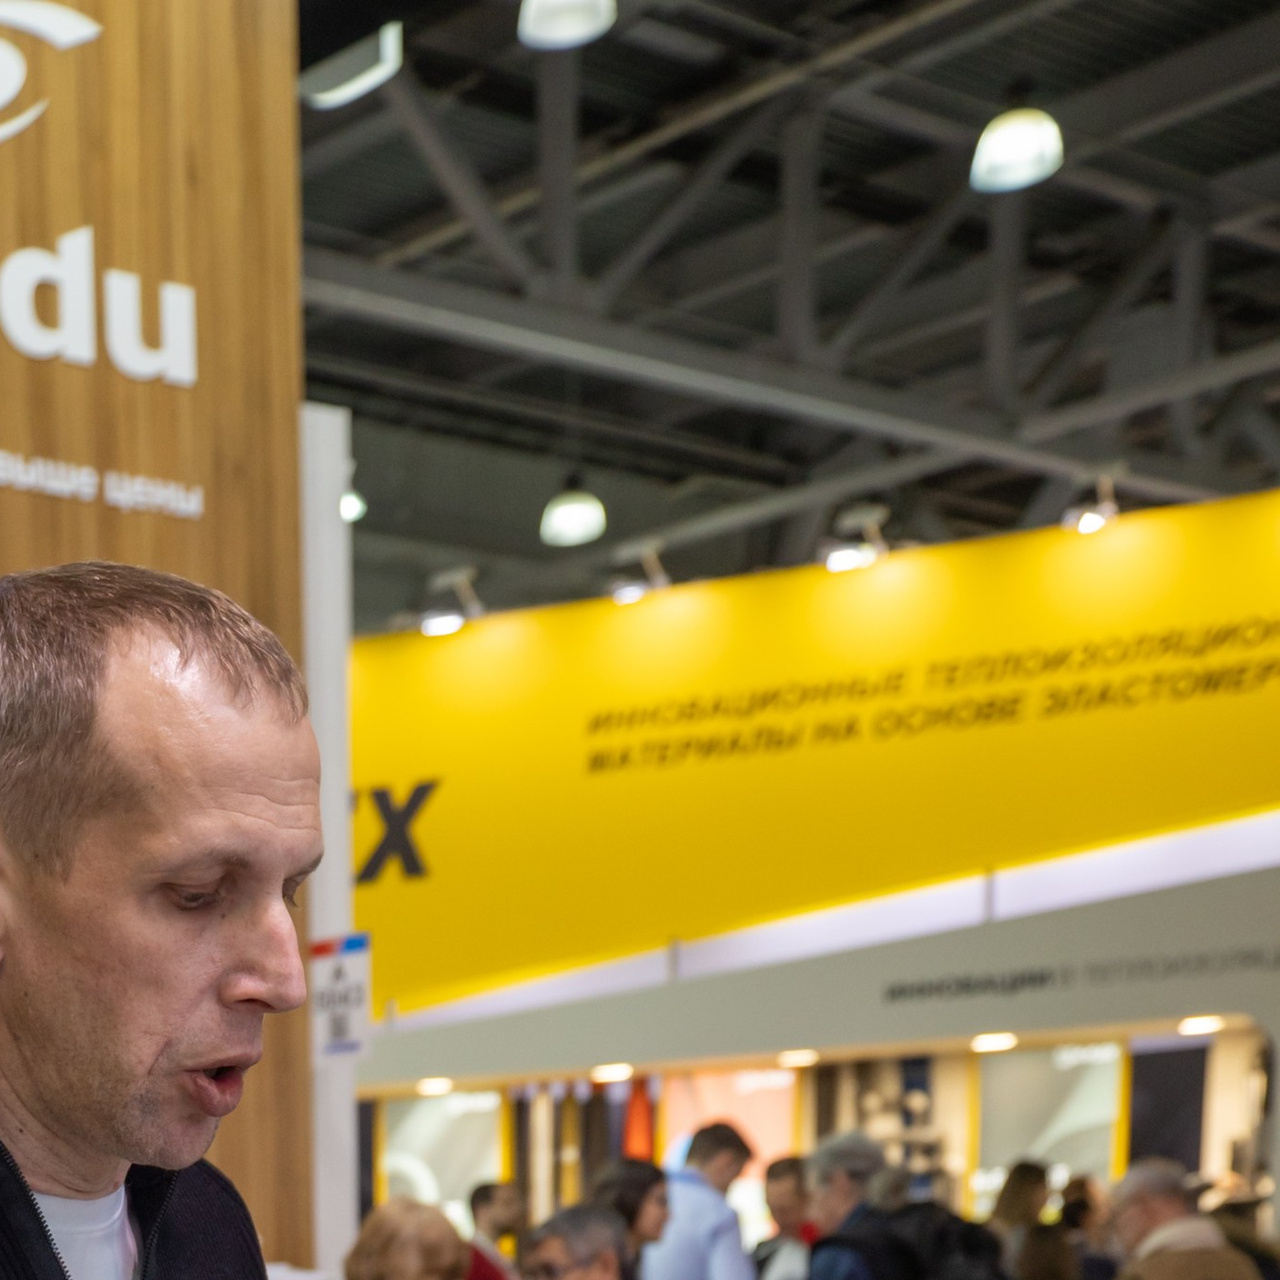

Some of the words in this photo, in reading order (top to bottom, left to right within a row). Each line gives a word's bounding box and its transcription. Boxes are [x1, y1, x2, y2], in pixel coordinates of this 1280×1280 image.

[103, 470, 205, 521] цены
[588, 668, 904, 735] ИННОВАЦИОННЫЕ
[587, 725, 803, 774] МАТЕРИАЛЫ
[812, 716, 861, 742] НА
[871, 698, 1020, 736] ОСНОВЕ
